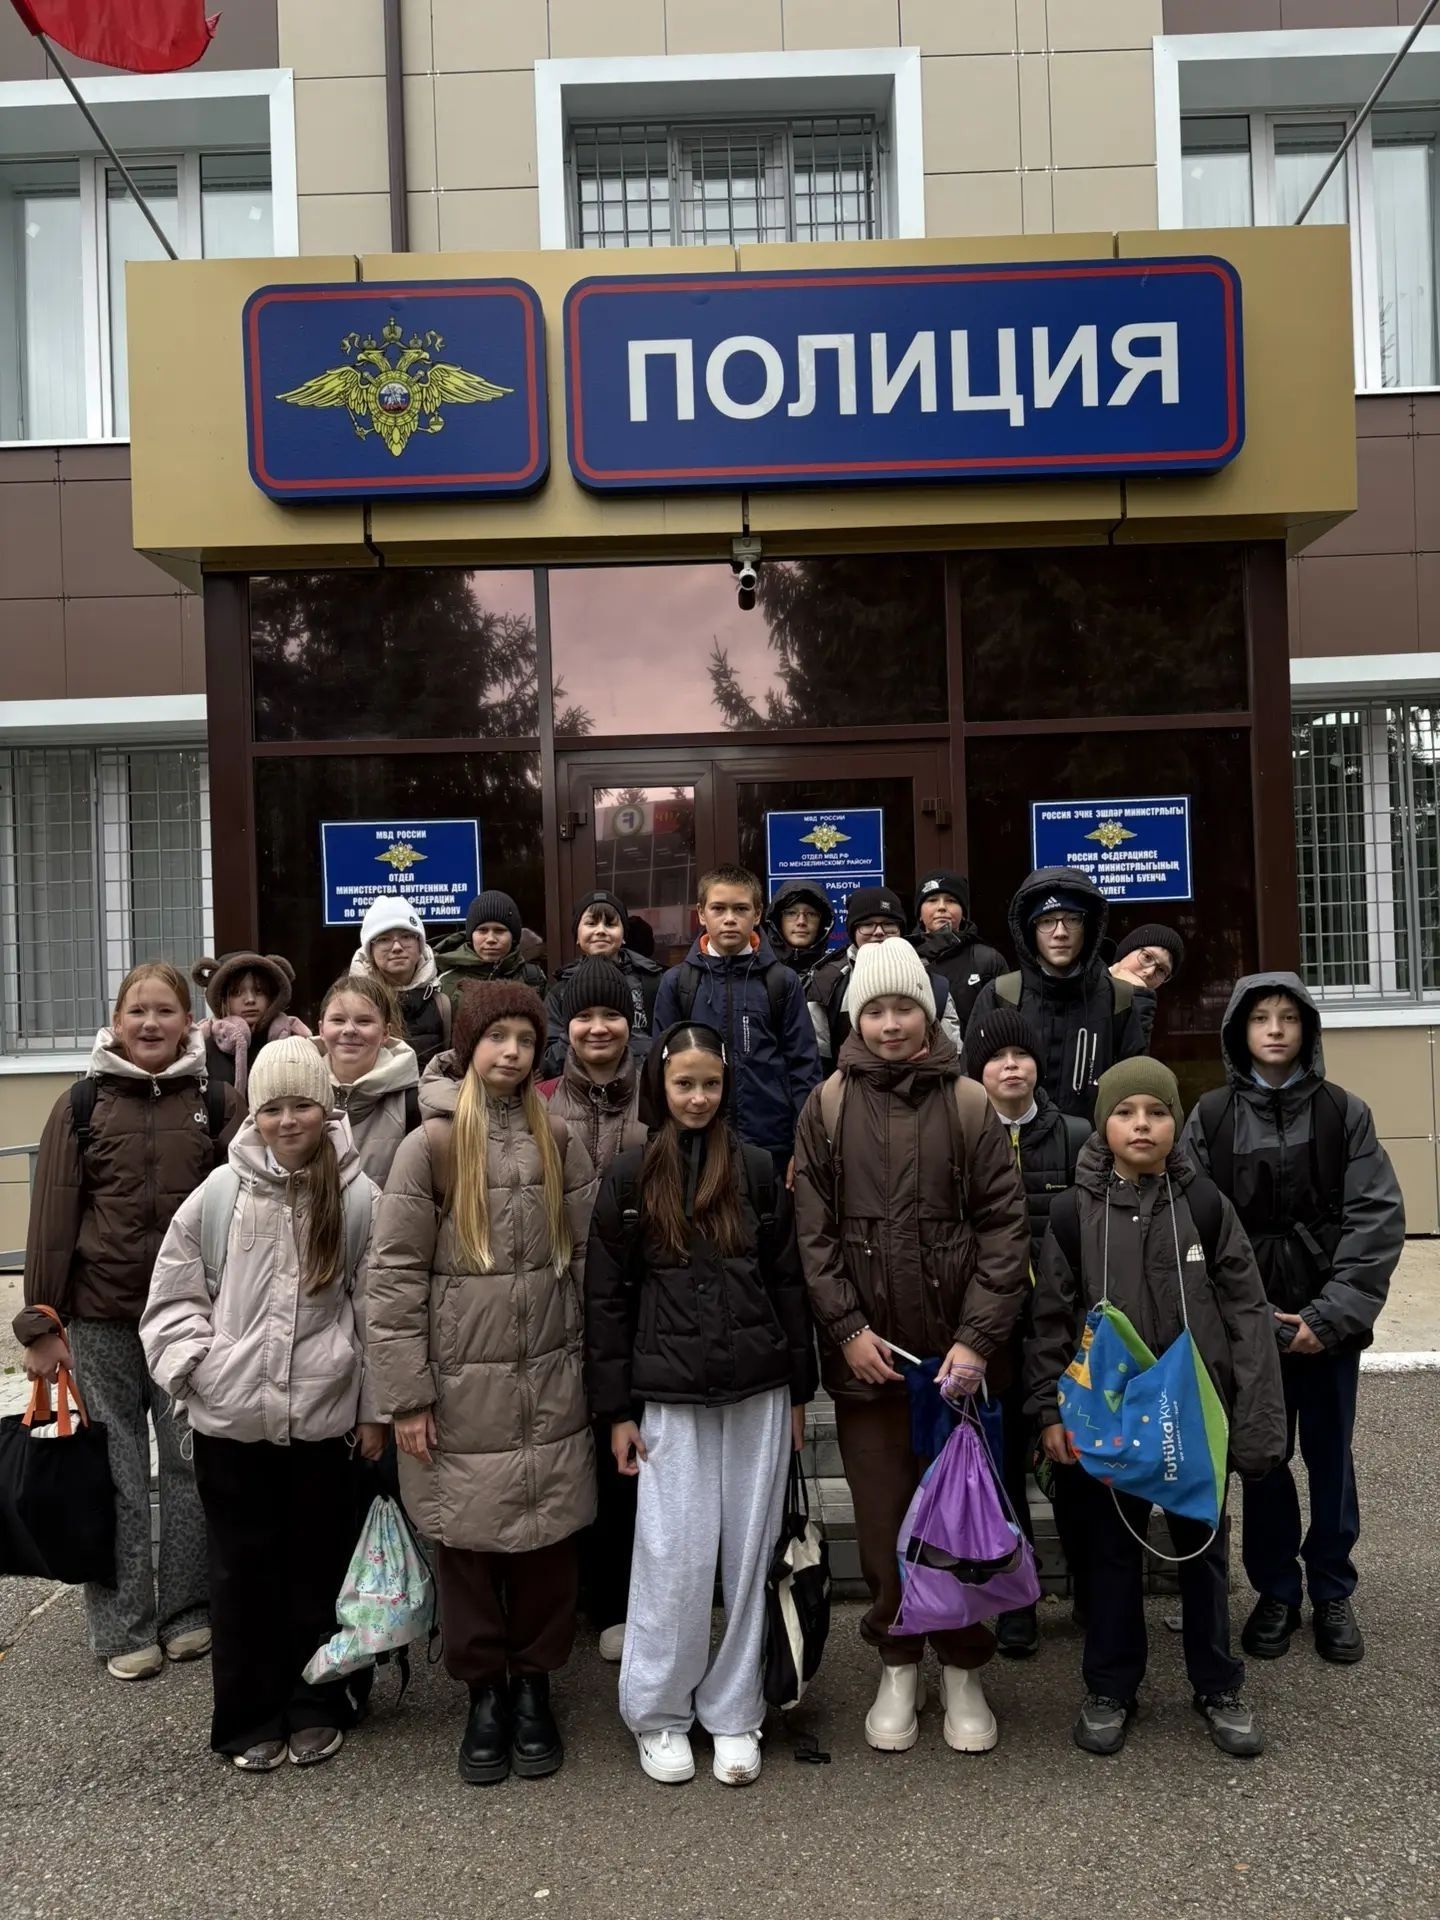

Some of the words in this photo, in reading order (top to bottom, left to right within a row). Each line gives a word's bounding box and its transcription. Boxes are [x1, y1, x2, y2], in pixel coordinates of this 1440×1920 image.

[626, 321, 1181, 427] ПОЛИЦИЯ
[1042, 811, 1071, 820] РОССИЯ
[1074, 810, 1092, 818] ЭЧКЕ
[1124, 807, 1184, 816] МИНИСТРЛЫГЫ
[376, 831, 394, 840] МВД
[397, 830, 426, 838] РОССИИ
[1067, 852, 1098, 862] РОССИЯ
[1101, 850, 1158, 861] ФЕДЕРАЦИЯСЕ
[389, 873, 414, 882] ОТДЕЛ
[1100, 874, 1133, 883] РАЙОНЫ
[1137, 873, 1166, 882] БУЕНЧА
[336, 885, 397, 895] МИНИСТЕРСТВА
[400, 884, 448, 893] ВНУТРЕННИХ
[452, 883, 467, 892] ДЕЛ
[408, 895, 455, 905] ФЕДЕРАЦИИ
[344, 909, 355, 917] ПО
[431, 905, 461, 915] РАЙОНУ
[1162, 1422, 1178, 1481] Futüka
